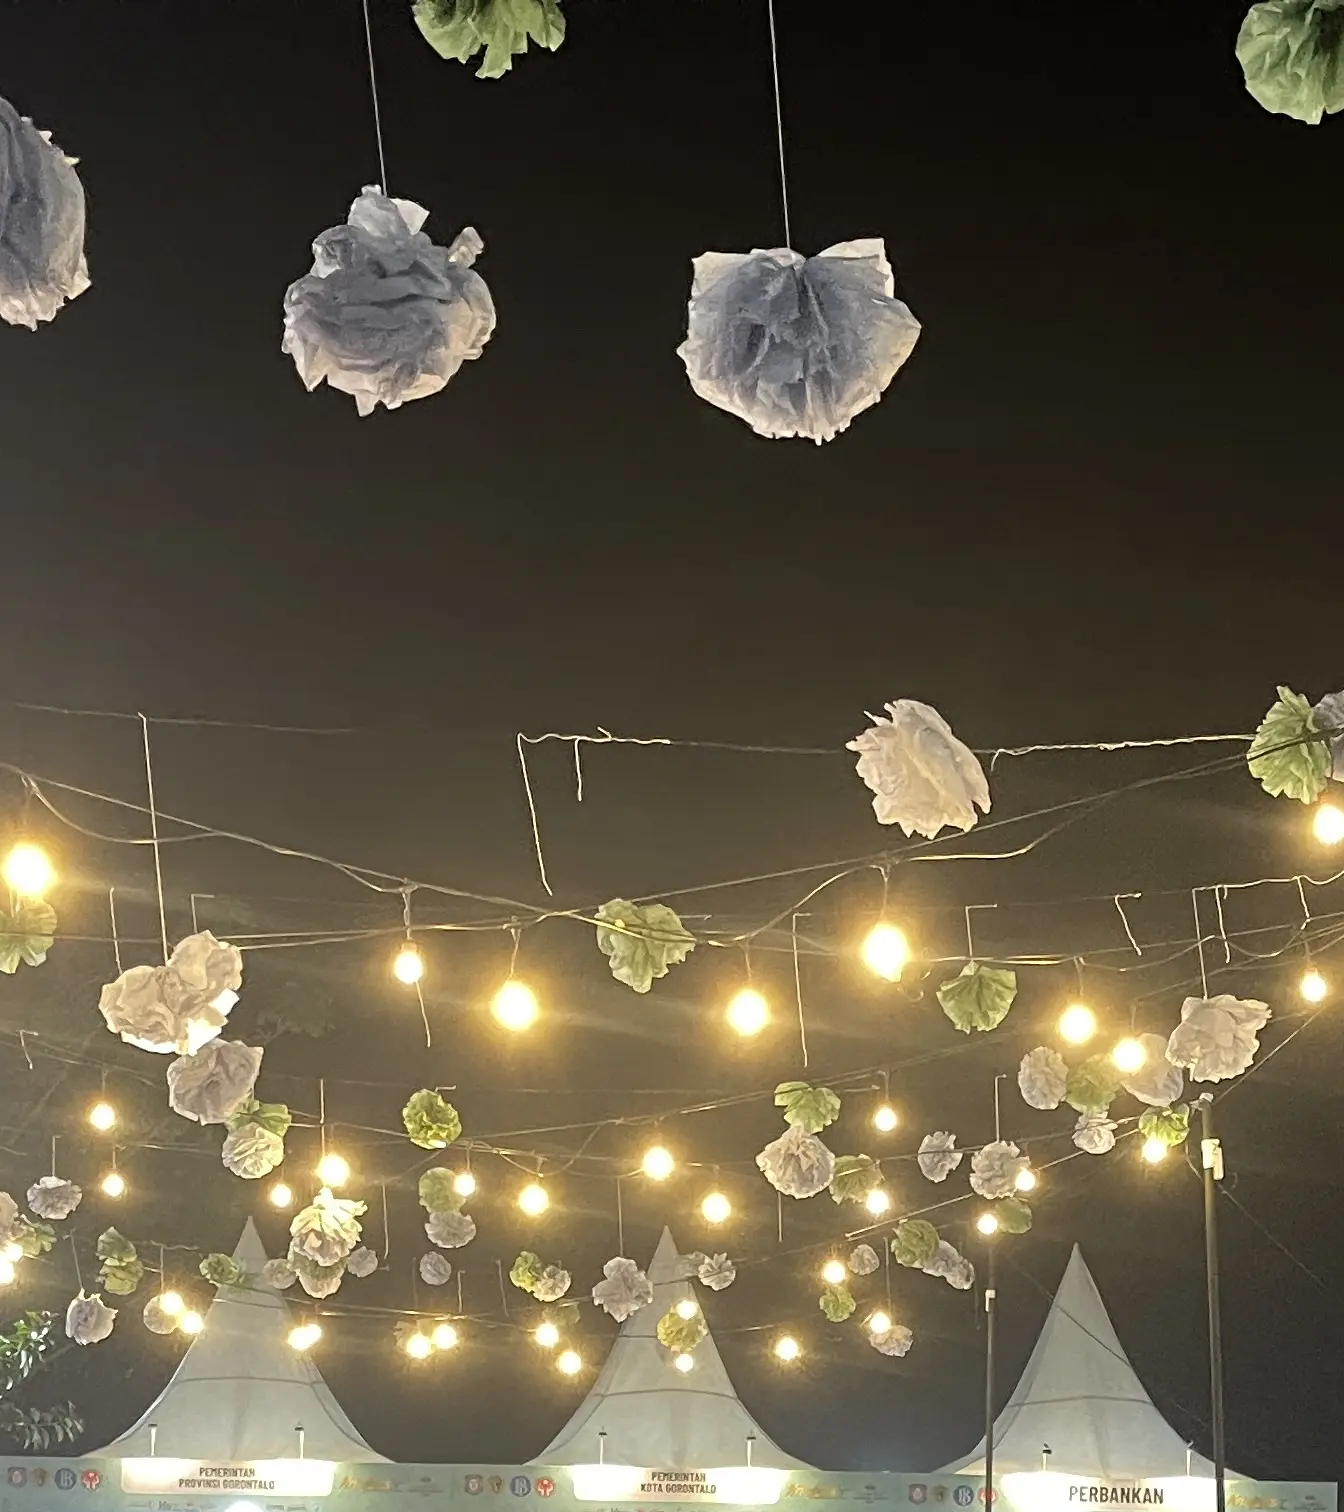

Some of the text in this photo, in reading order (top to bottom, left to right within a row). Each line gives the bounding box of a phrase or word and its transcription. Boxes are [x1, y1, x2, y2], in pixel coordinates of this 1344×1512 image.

[199, 1467, 256, 1478] PEMERINTAH
[651, 1471, 706, 1482] PEMERINTAH
[178, 1478, 275, 1490] PROVINSI GORONTALO
[640, 1483, 717, 1494] KOTA GORONTALO
[1069, 1485, 1164, 1504] PERBANKAN
